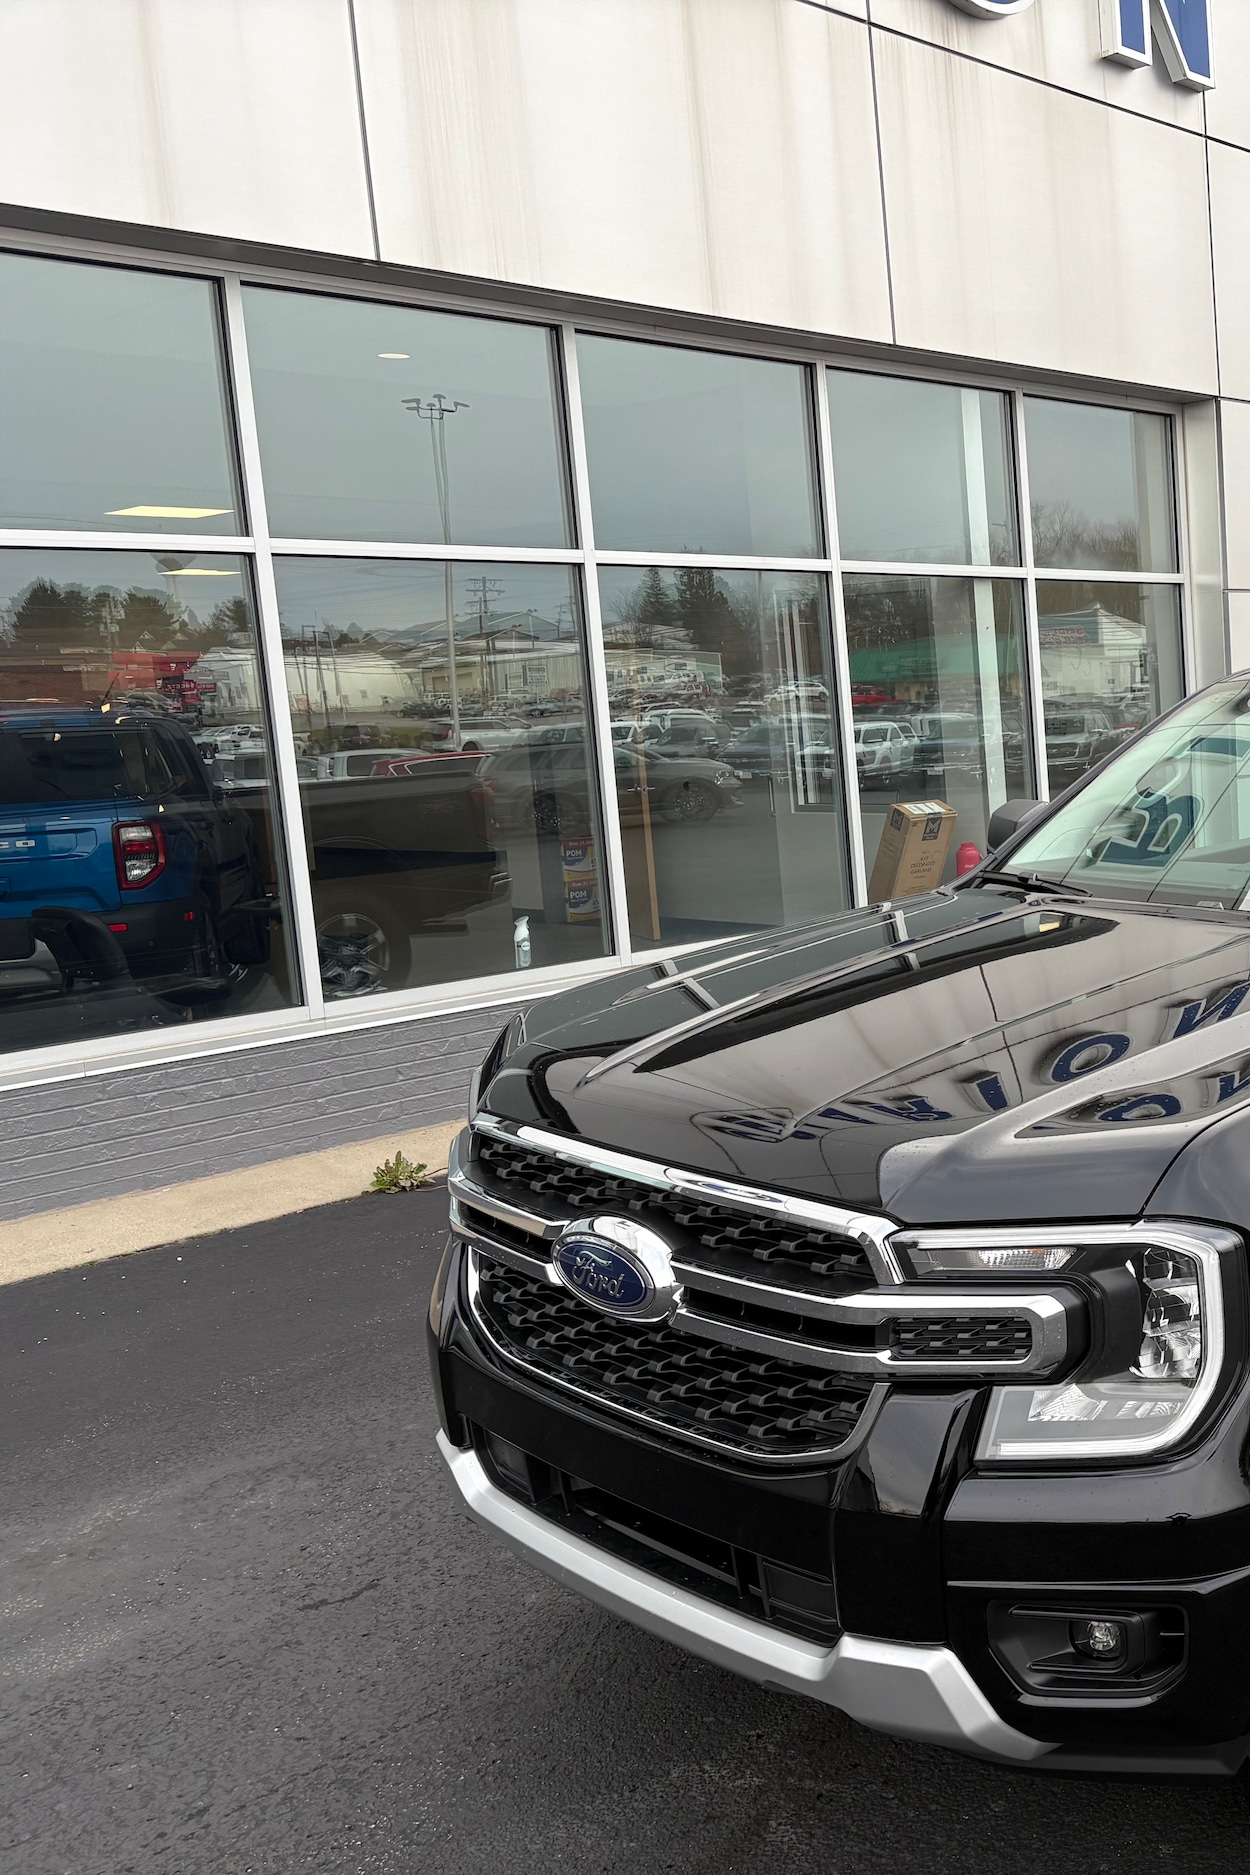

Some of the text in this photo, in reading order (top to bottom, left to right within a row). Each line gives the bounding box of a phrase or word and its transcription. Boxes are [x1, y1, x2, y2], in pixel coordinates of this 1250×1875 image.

[910, 861, 935, 869] DECORATED
[570, 891, 587, 899] POM
[571, 1250, 625, 1299] Ford
